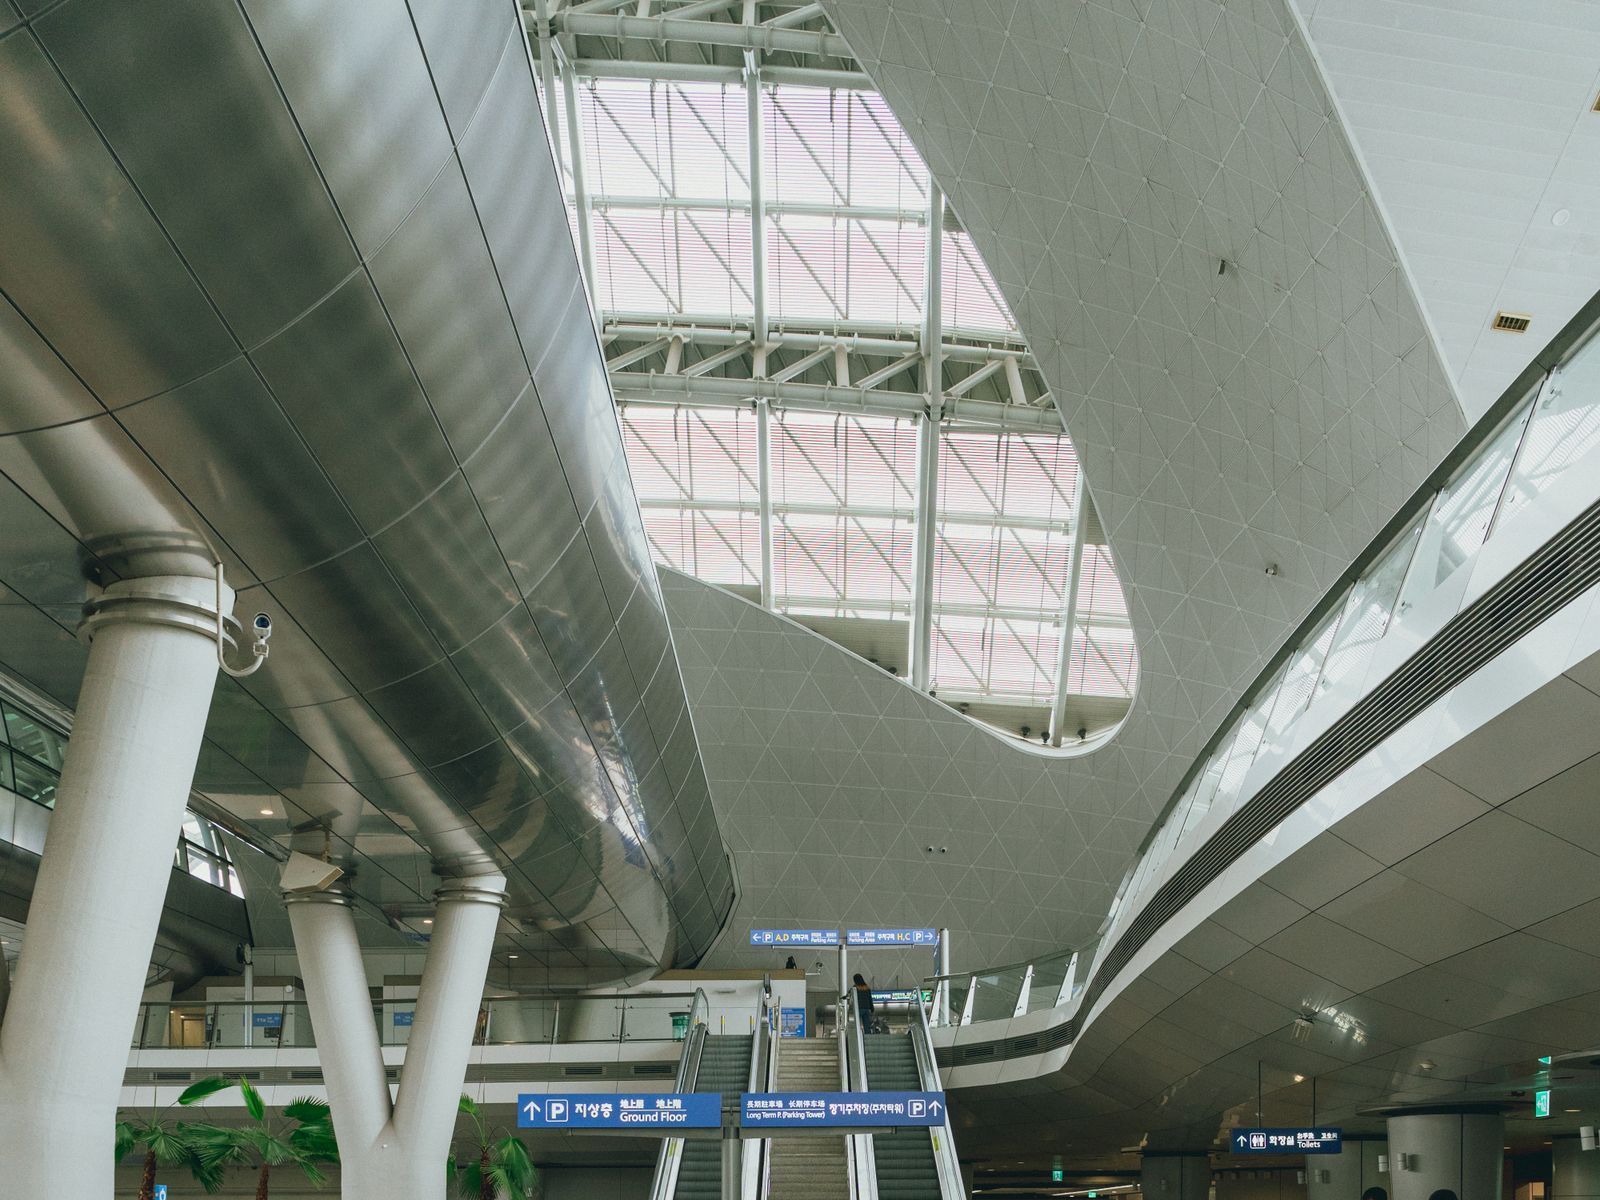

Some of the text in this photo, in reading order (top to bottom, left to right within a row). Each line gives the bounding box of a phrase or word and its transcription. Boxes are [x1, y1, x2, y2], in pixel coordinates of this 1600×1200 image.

[551, 1103, 613, 1119] P 지상층
[912, 1102, 923, 1115] P
[620, 1111, 687, 1122] Ground Floor
[746, 1111, 761, 1120] Long
[761, 1111, 777, 1119] Term
[782, 1111, 805, 1120] (Parking
[805, 1111, 825, 1120] Tower)
[1269, 1135, 1295, 1146] 화장실
[1297, 1141, 1321, 1149] Toilets
